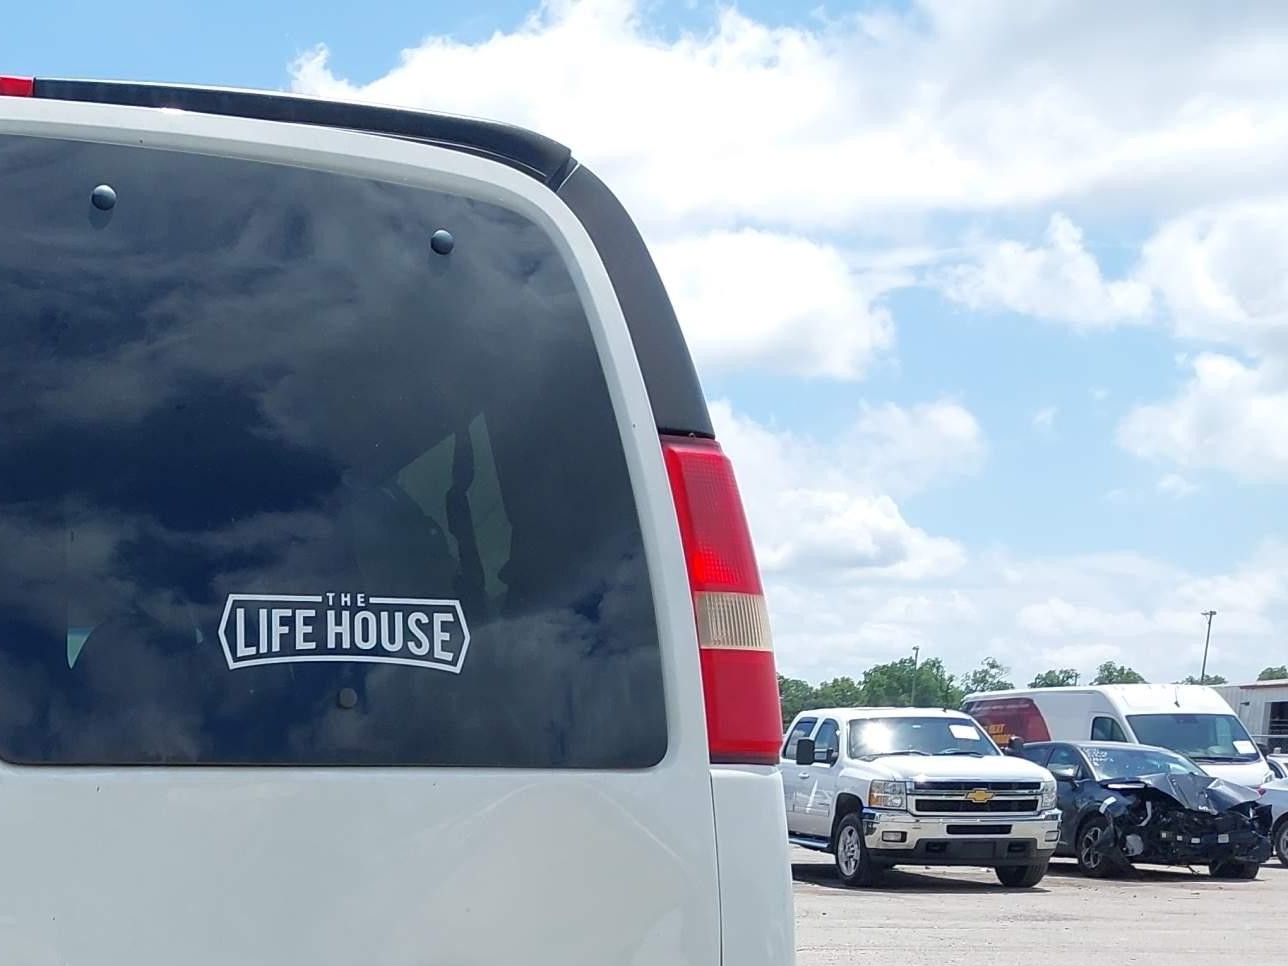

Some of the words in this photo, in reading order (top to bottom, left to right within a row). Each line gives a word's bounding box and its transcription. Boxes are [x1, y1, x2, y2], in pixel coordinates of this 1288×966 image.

[326, 592, 366, 607] THE
[236, 608, 316, 658] LIFE
[327, 610, 455, 662] HOUSE
